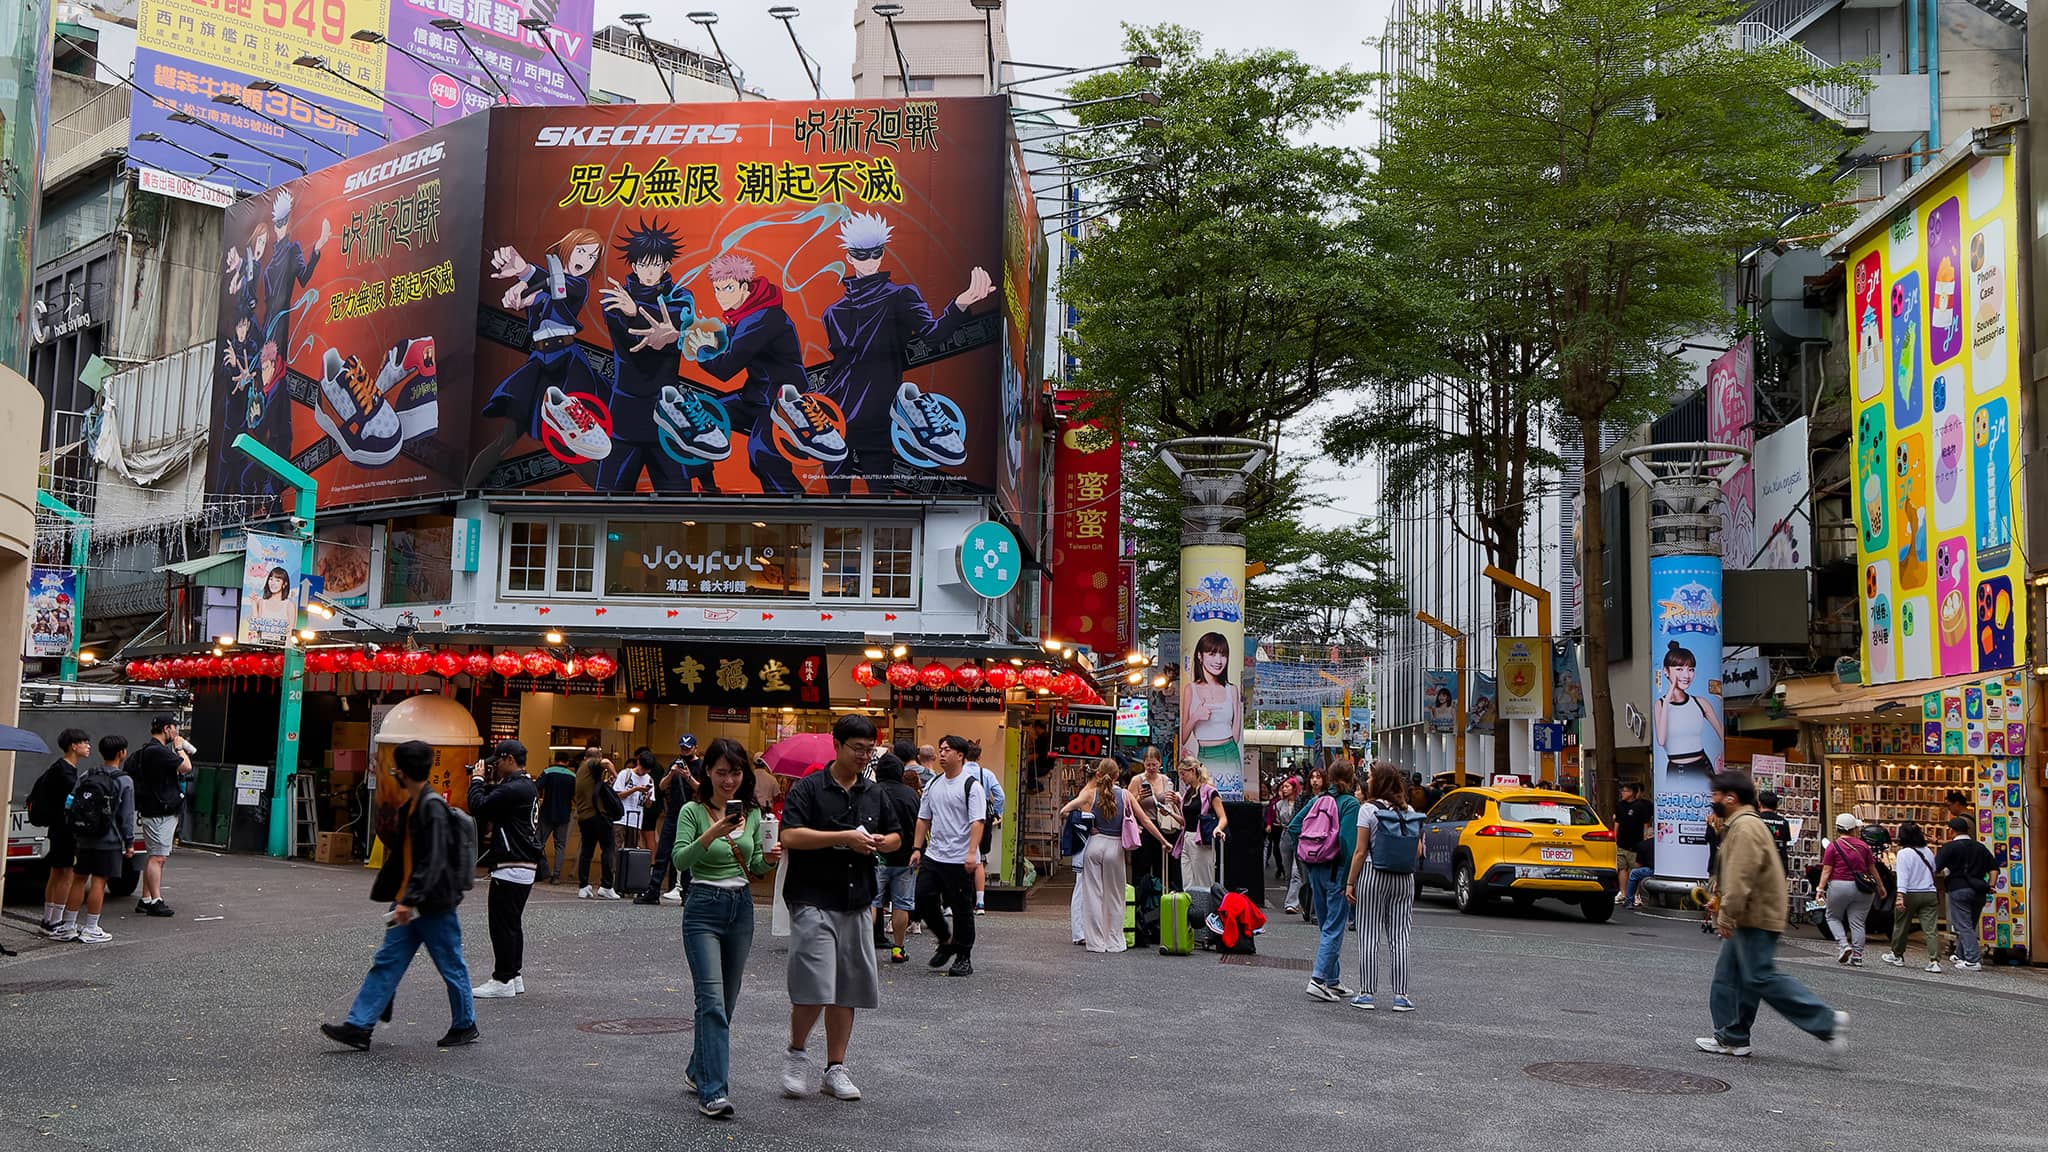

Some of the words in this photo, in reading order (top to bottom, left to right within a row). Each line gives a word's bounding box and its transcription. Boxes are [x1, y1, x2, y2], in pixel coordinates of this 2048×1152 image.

[156, 9, 258, 50] 西門旗艦店
[526, 27, 582, 58] KTV
[413, 27, 457, 55] 信義店
[525, 62, 565, 88] 西門店
[265, 90, 337, 129] 359
[535, 123, 739, 148] SKECHERS
[343, 141, 446, 195] SKECHERS
[558, 157, 724, 208] 咒力無限
[736, 157, 903, 206] 潮起不滅
[1976, 267, 1997, 286] Phone
[325, 280, 386, 325] 咒力無限
[390, 260, 456, 306] 潮起不滅
[1980, 284, 1994, 300] Case
[53, 321, 67, 337] hair
[67, 312, 91, 333] styling
[1976, 312, 2001, 333] Souvenir
[1973, 325, 2006, 349] Accessories
[1091, 543, 1104, 552] Gift
[672, 655, 792, 694] 幸福堂
[289, 690, 302, 700] 20
[1067, 733, 1101, 756] 80
